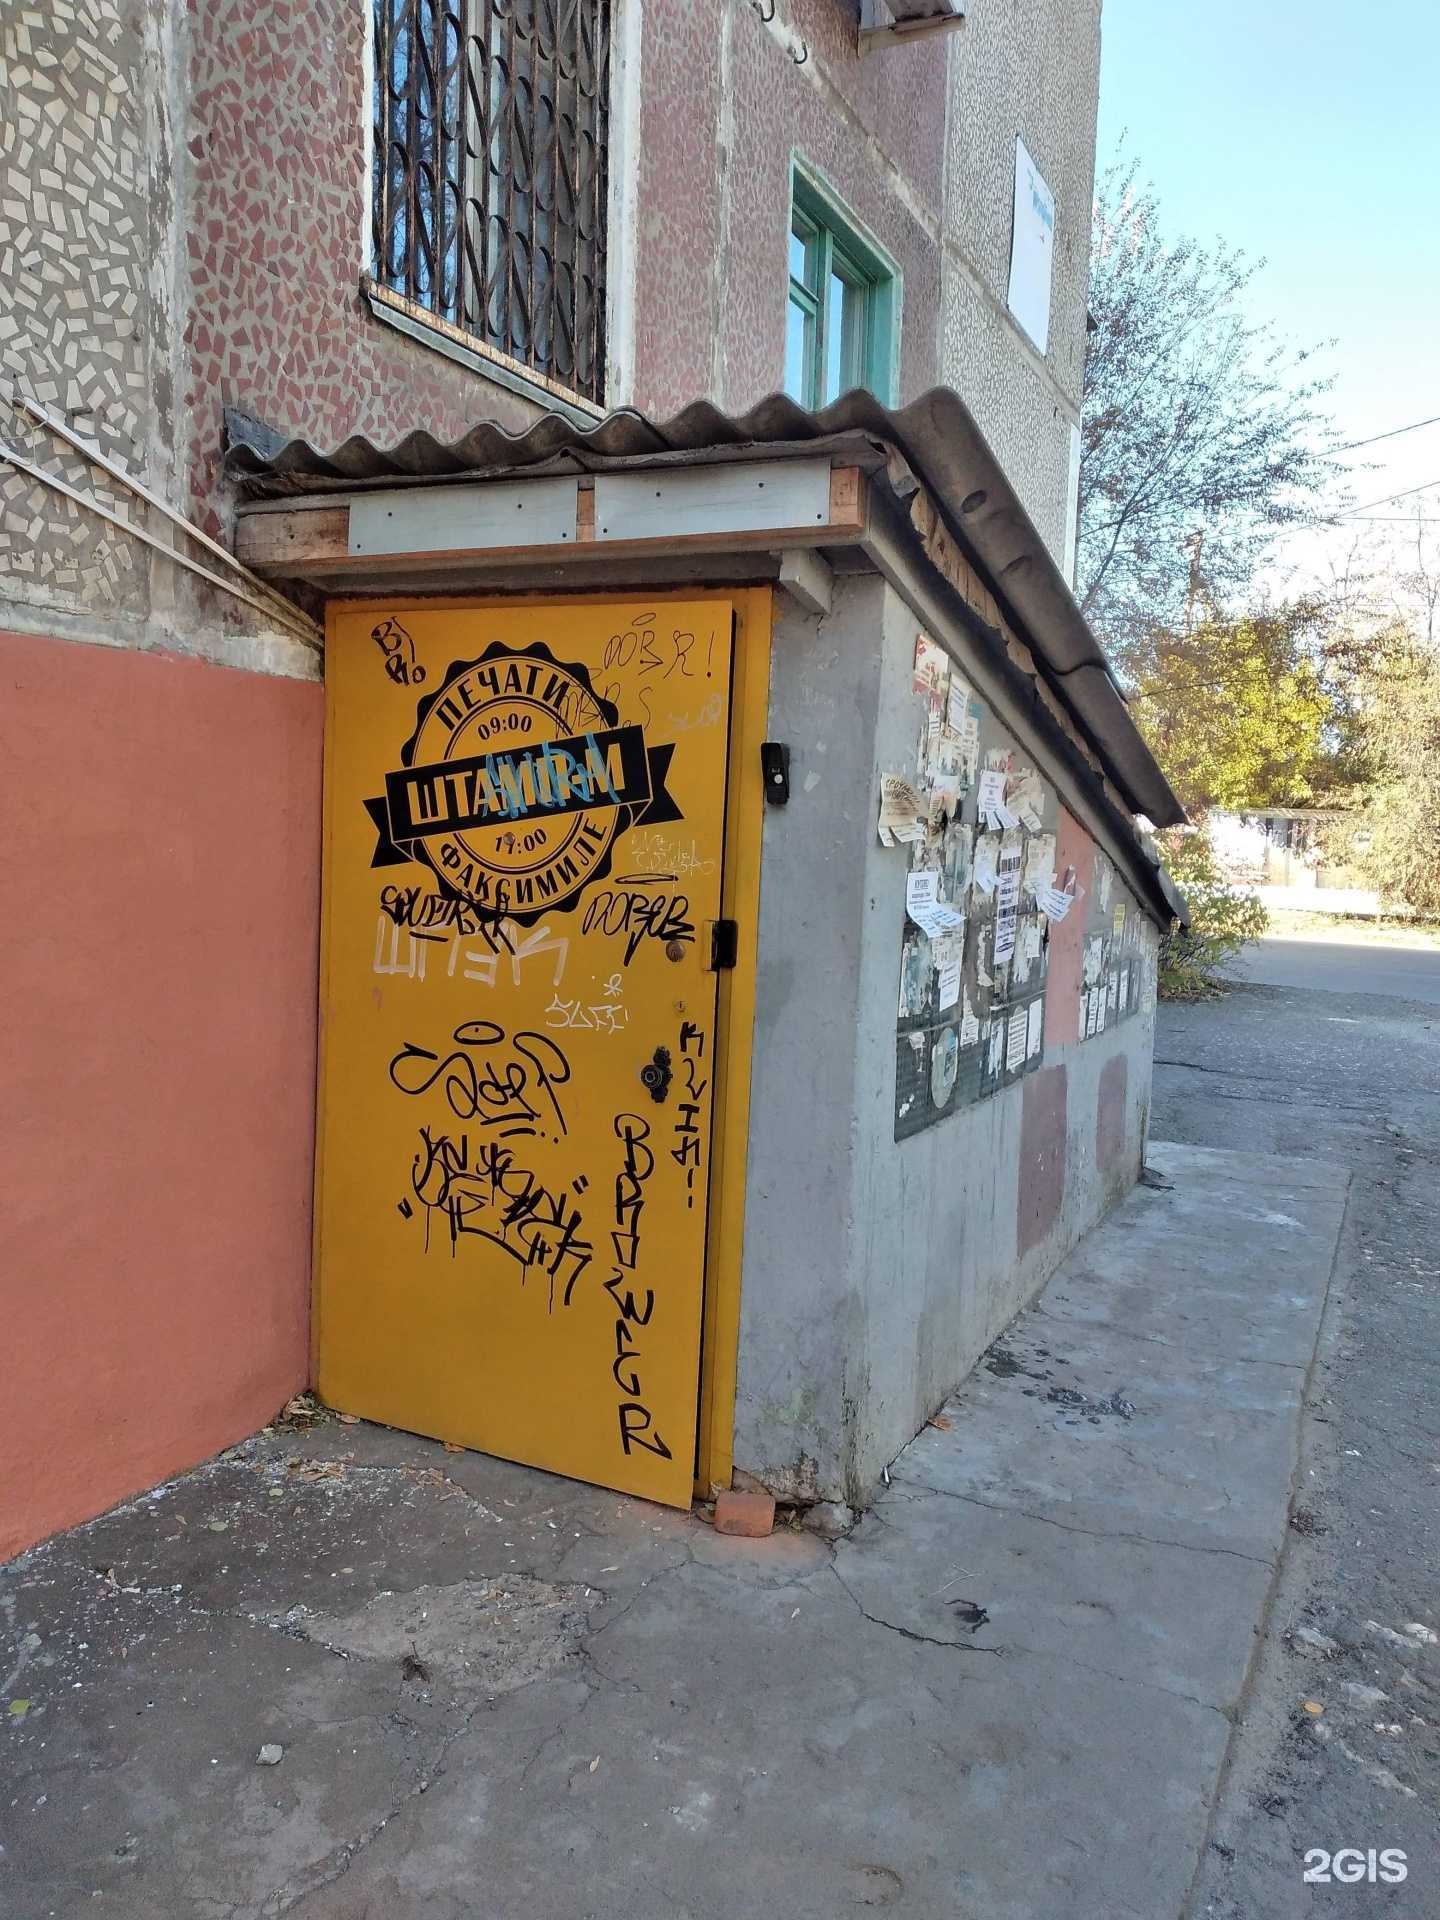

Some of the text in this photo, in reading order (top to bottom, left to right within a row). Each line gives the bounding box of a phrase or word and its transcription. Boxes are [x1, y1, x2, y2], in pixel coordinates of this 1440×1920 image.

[435, 663, 571, 732] ПЕЧАТИ
[477, 712, 533, 741] 09:00
[440, 817, 608, 906] ФАКСИМИЛЕ
